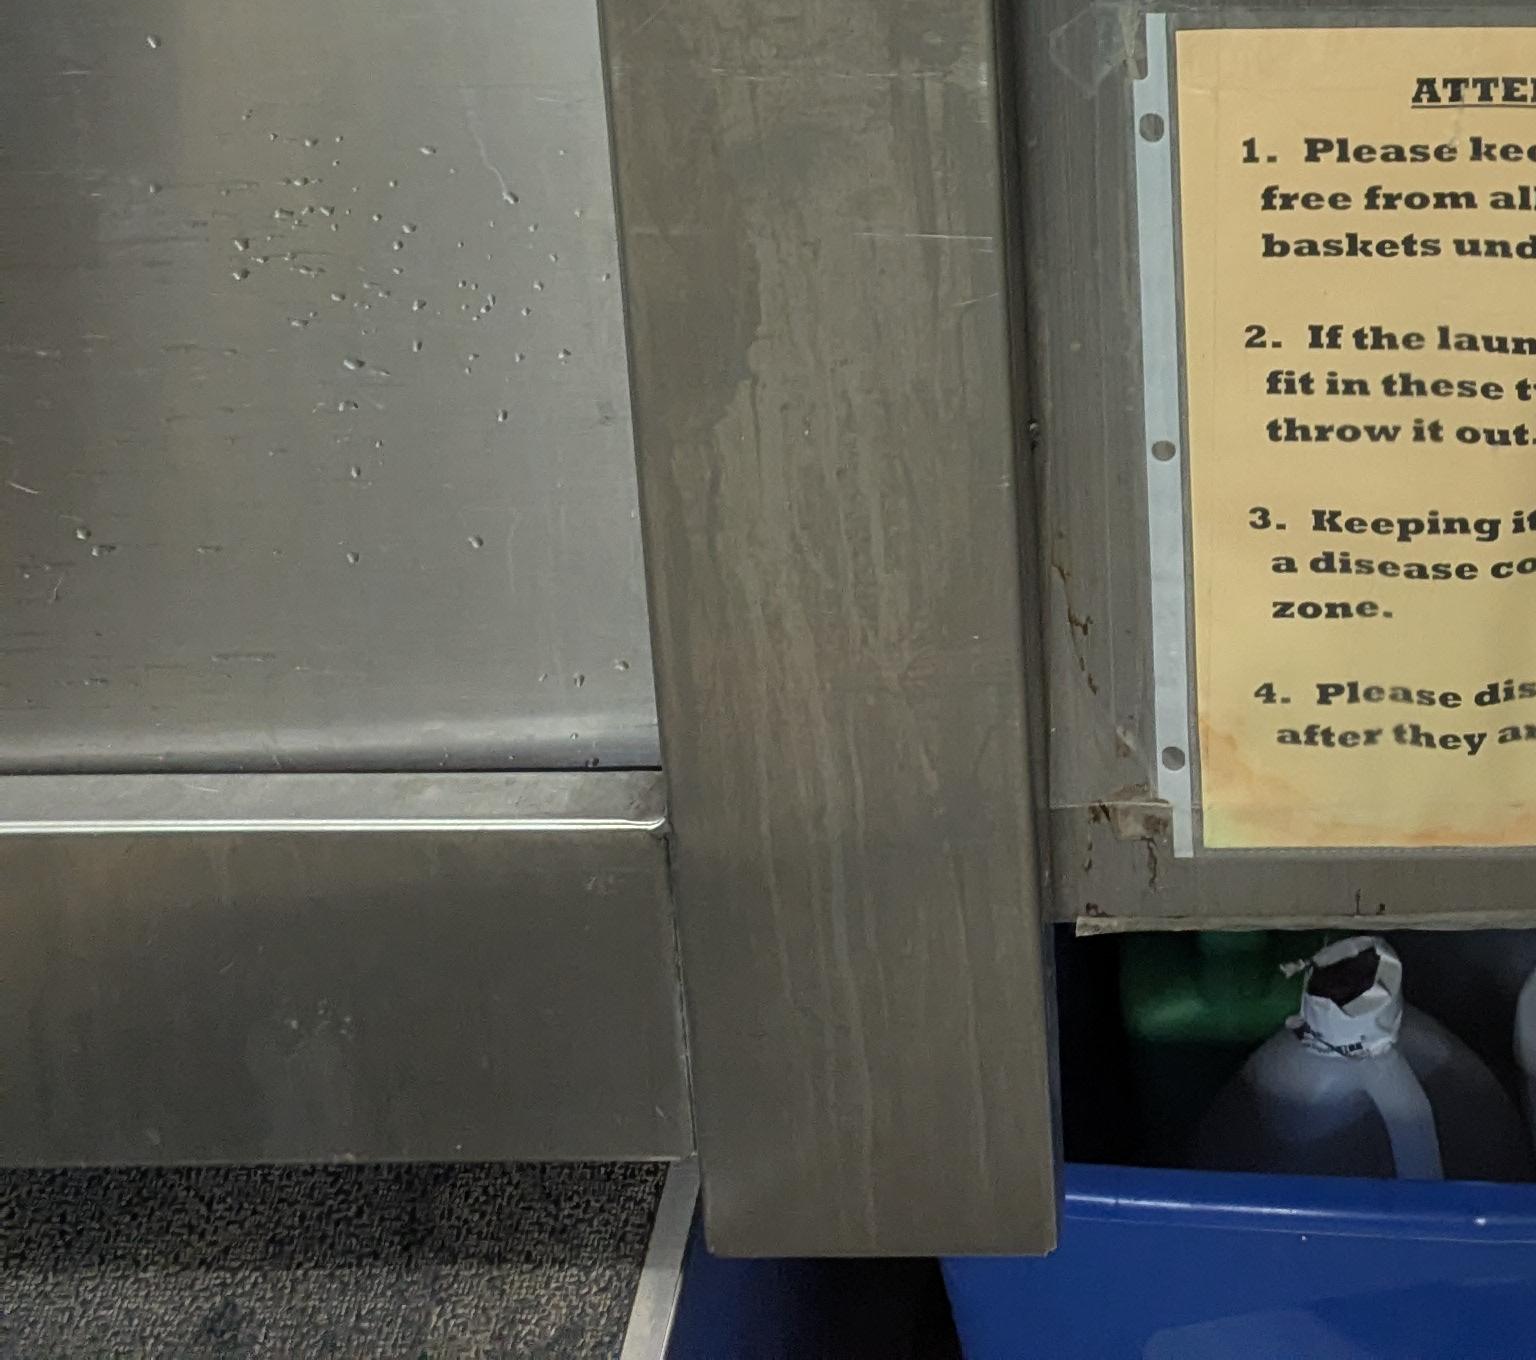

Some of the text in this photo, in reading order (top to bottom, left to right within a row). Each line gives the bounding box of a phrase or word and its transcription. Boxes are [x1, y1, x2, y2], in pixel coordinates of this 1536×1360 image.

[1242, 137, 1278, 164] 1.
[1303, 137, 1458, 164] Please
[1260, 184, 1353, 212] free
[1364, 184, 1478, 211] from
[1261, 232, 1442, 258] baskets
[1244, 324, 1283, 349] 2.
[1307, 324, 1344, 350] If
[1351, 325, 1426, 351] the
[1266, 369, 1315, 396] fit
[1326, 370, 1371, 396] in
[1381, 372, 1504, 401] these
[1266, 417, 1402, 443] throw
[1412, 417, 1444, 443] it
[1248, 506, 1287, 531] 3.
[1311, 509, 1502, 543] Keeping
[1271, 556, 1299, 574] a
[1309, 550, 1479, 581] disease
[1272, 600, 1393, 620] zone.
[1253, 682, 1291, 705] 4.
[1315, 680, 1463, 709] Please
[1276, 723, 1383, 748] after
[1392, 723, 1488, 756] they
